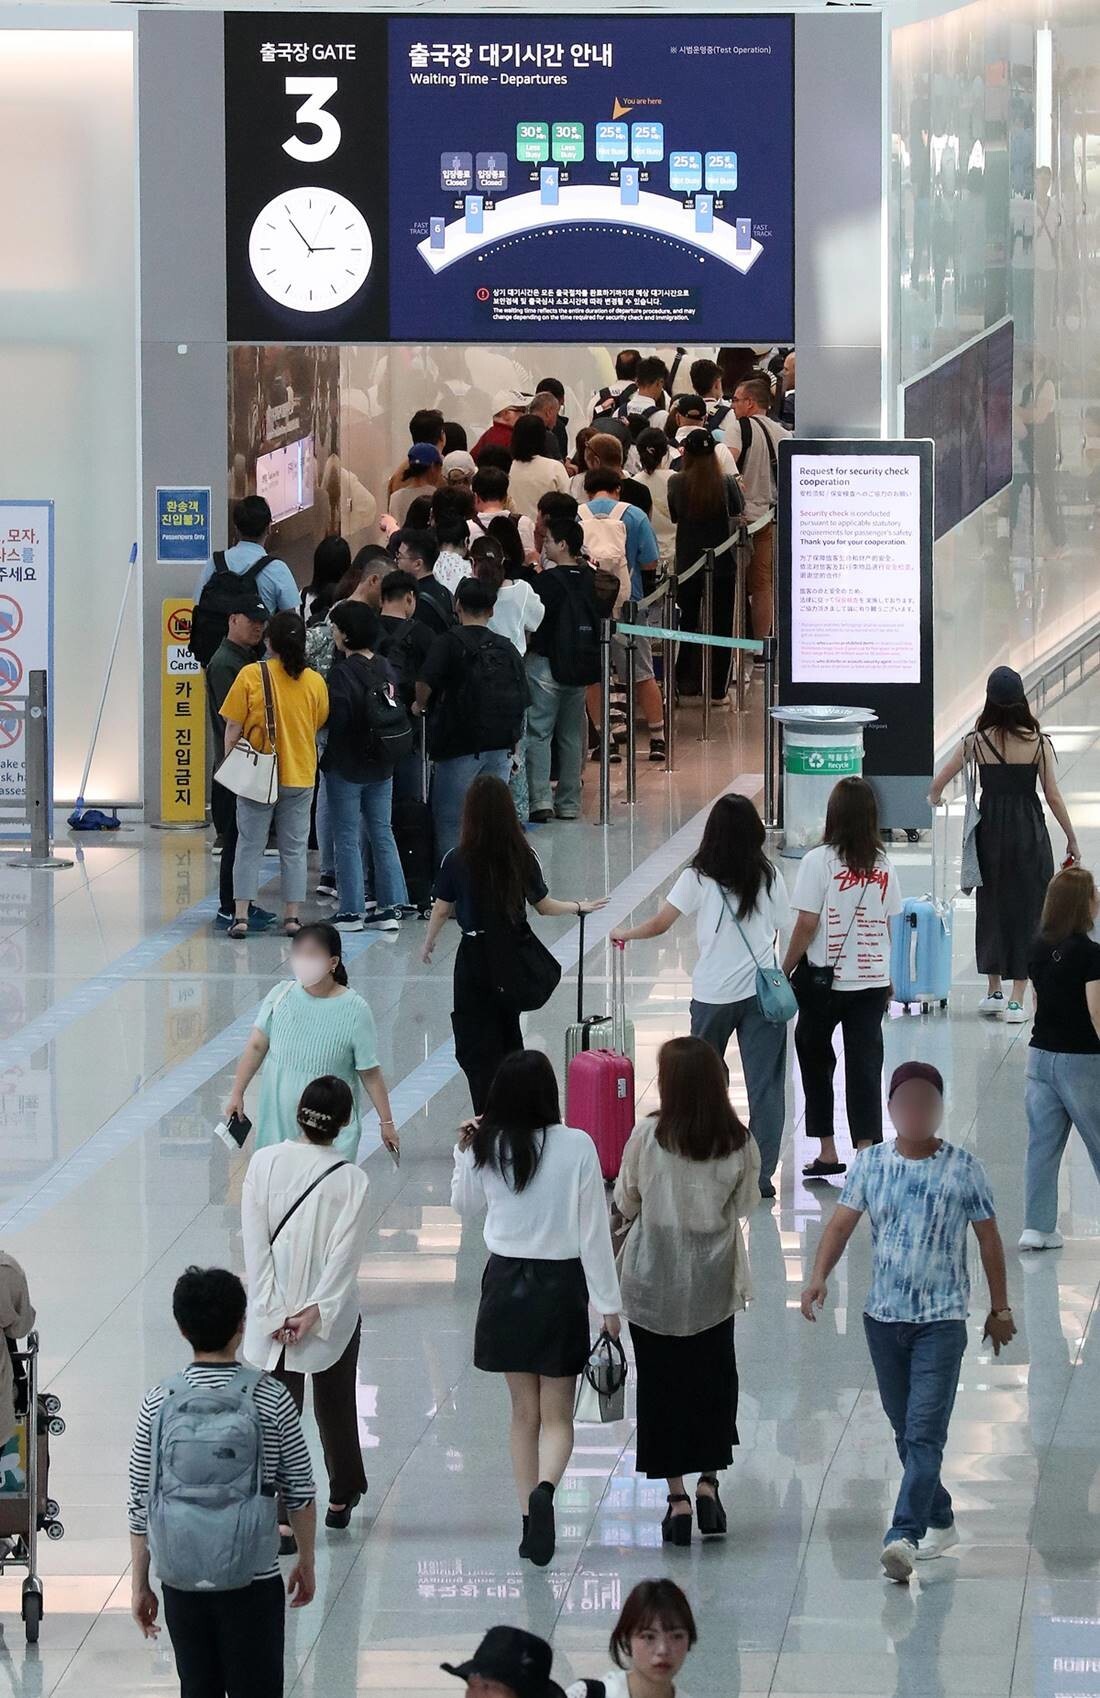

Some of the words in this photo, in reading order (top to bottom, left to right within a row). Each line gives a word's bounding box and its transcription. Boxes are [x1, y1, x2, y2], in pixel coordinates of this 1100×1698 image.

[259, 42, 310, 63] 출국장
[312, 43, 357, 61] GATE
[408, 42, 473, 68] 출국장
[478, 43, 565, 68] 대기시간
[571, 43, 613, 68] 안내
[733, 45, 772, 55] Operation)
[410, 73, 456, 87] Waiting
[458, 73, 489, 85] Time
[500, 73, 568, 88] Departures
[647, 97, 662, 105] here
[281, 76, 342, 163] 3
[520, 126, 536, 138] 30
[556, 126, 571, 138] 30
[600, 126, 615, 138] 25
[635, 126, 650, 138] 25
[673, 155, 688, 167] 25
[709, 155, 723, 167] 25
[545, 175, 554, 186] 4
[625, 174, 634, 186] 3
[470, 202, 478, 214] 5
[700, 202, 708, 214] 2
[434, 224, 441, 233] 6
[741, 225, 746, 234] 1
[492, 288, 506, 297] 상기
[507, 288, 540, 297] 대기시간은
[625, 297, 633, 306] 수
[504, 307, 523, 315] waiting
[615, 307, 642, 315] departure
[684, 308, 696, 316] may
[513, 313, 541, 321] depending
[800, 467, 834, 476] Request
[835, 467, 847, 476] for
[849, 467, 882, 477] security
[884, 467, 909, 476] check
[799, 478, 850, 488] cooperation
[166, 500, 199, 513] 환송객
[800, 510, 828, 519] Security
[7, 528, 40, 545] 모자,
[844, 529, 853, 537] for
[800, 538, 821, 546] Thank
[823, 539, 836, 547] you
[836, 538, 847, 546] for
[847, 539, 863, 547] your
[178, 645, 193, 659] No
[169, 660, 199, 672] Carts
[174, 681, 193, 718] 카트
[174, 728, 193, 807] 진입금지
[828, 761, 850, 770] Recycle
